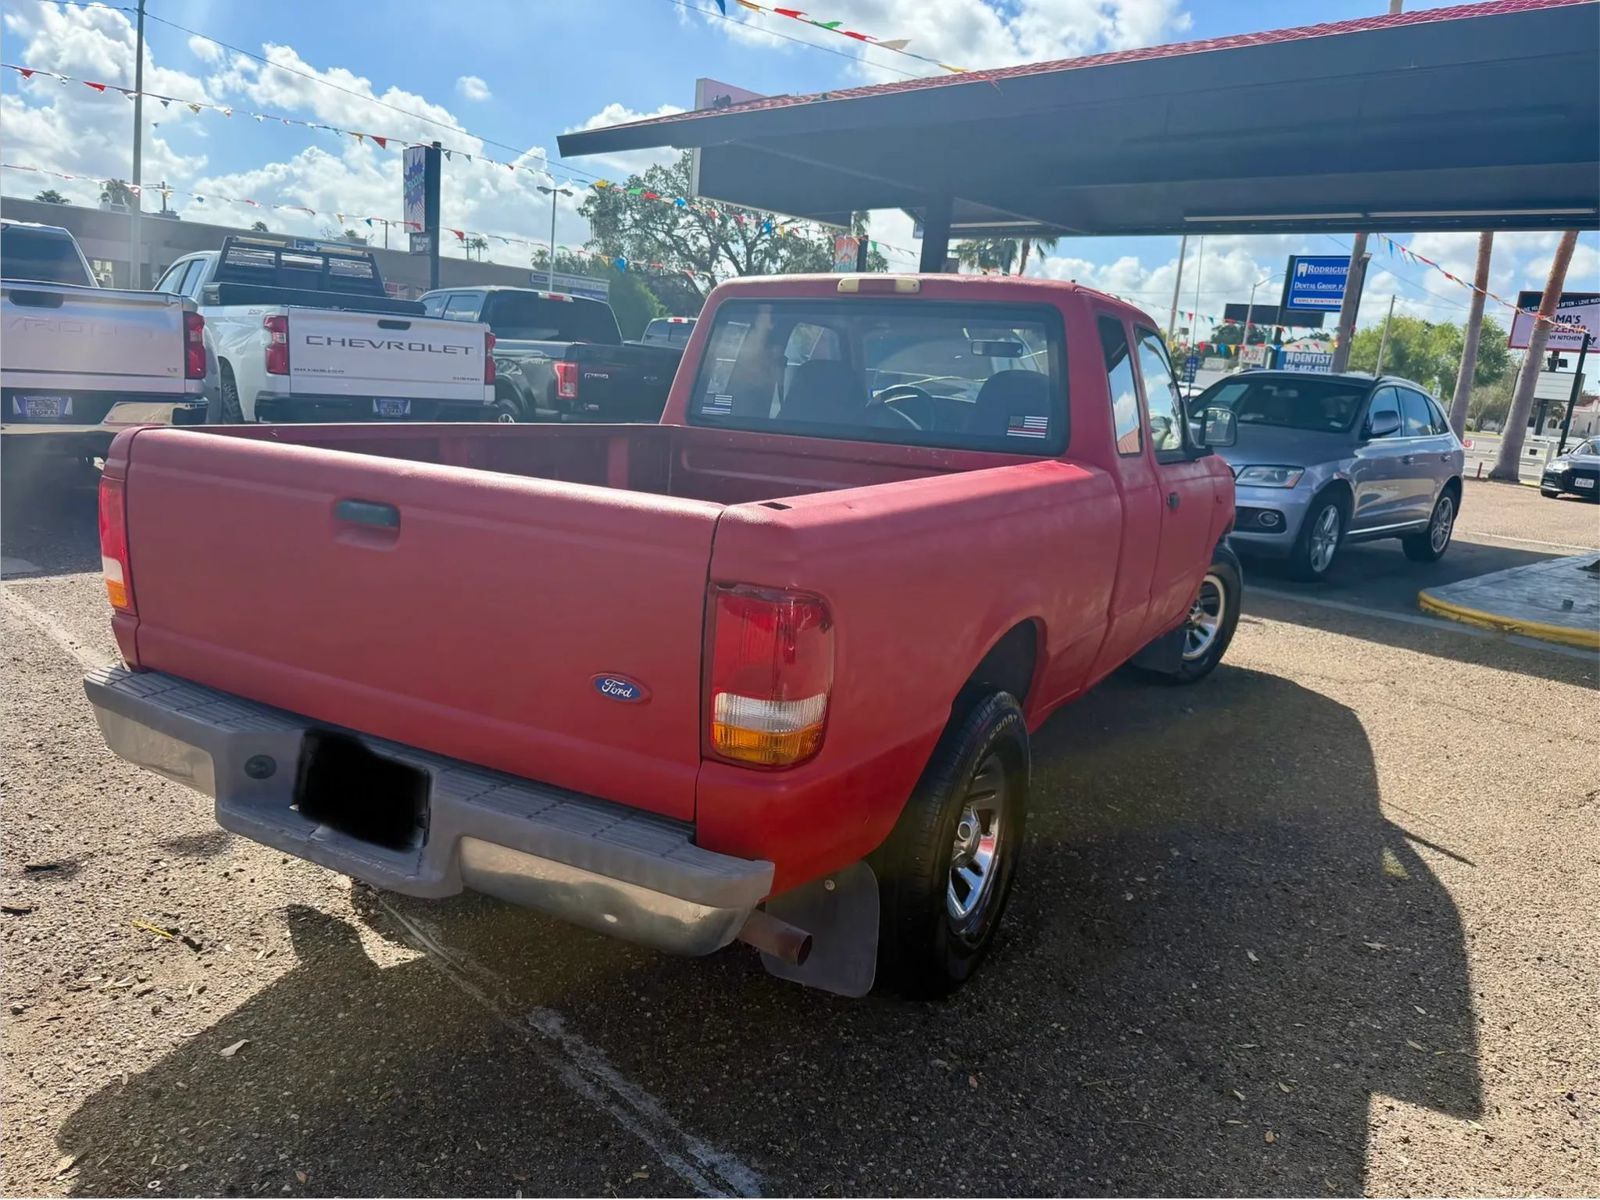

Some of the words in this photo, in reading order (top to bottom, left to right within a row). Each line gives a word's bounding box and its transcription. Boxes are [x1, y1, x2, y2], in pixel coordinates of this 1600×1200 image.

[1307, 264, 1350, 275] RODRIGUE
[1294, 281, 1316, 290] DENTAL
[1553, 314, 1582, 325] MA'S
[306, 335, 474, 356] CHEVROLET
[1294, 352, 1331, 365] DENTIST
[601, 678, 633, 698] Ford
